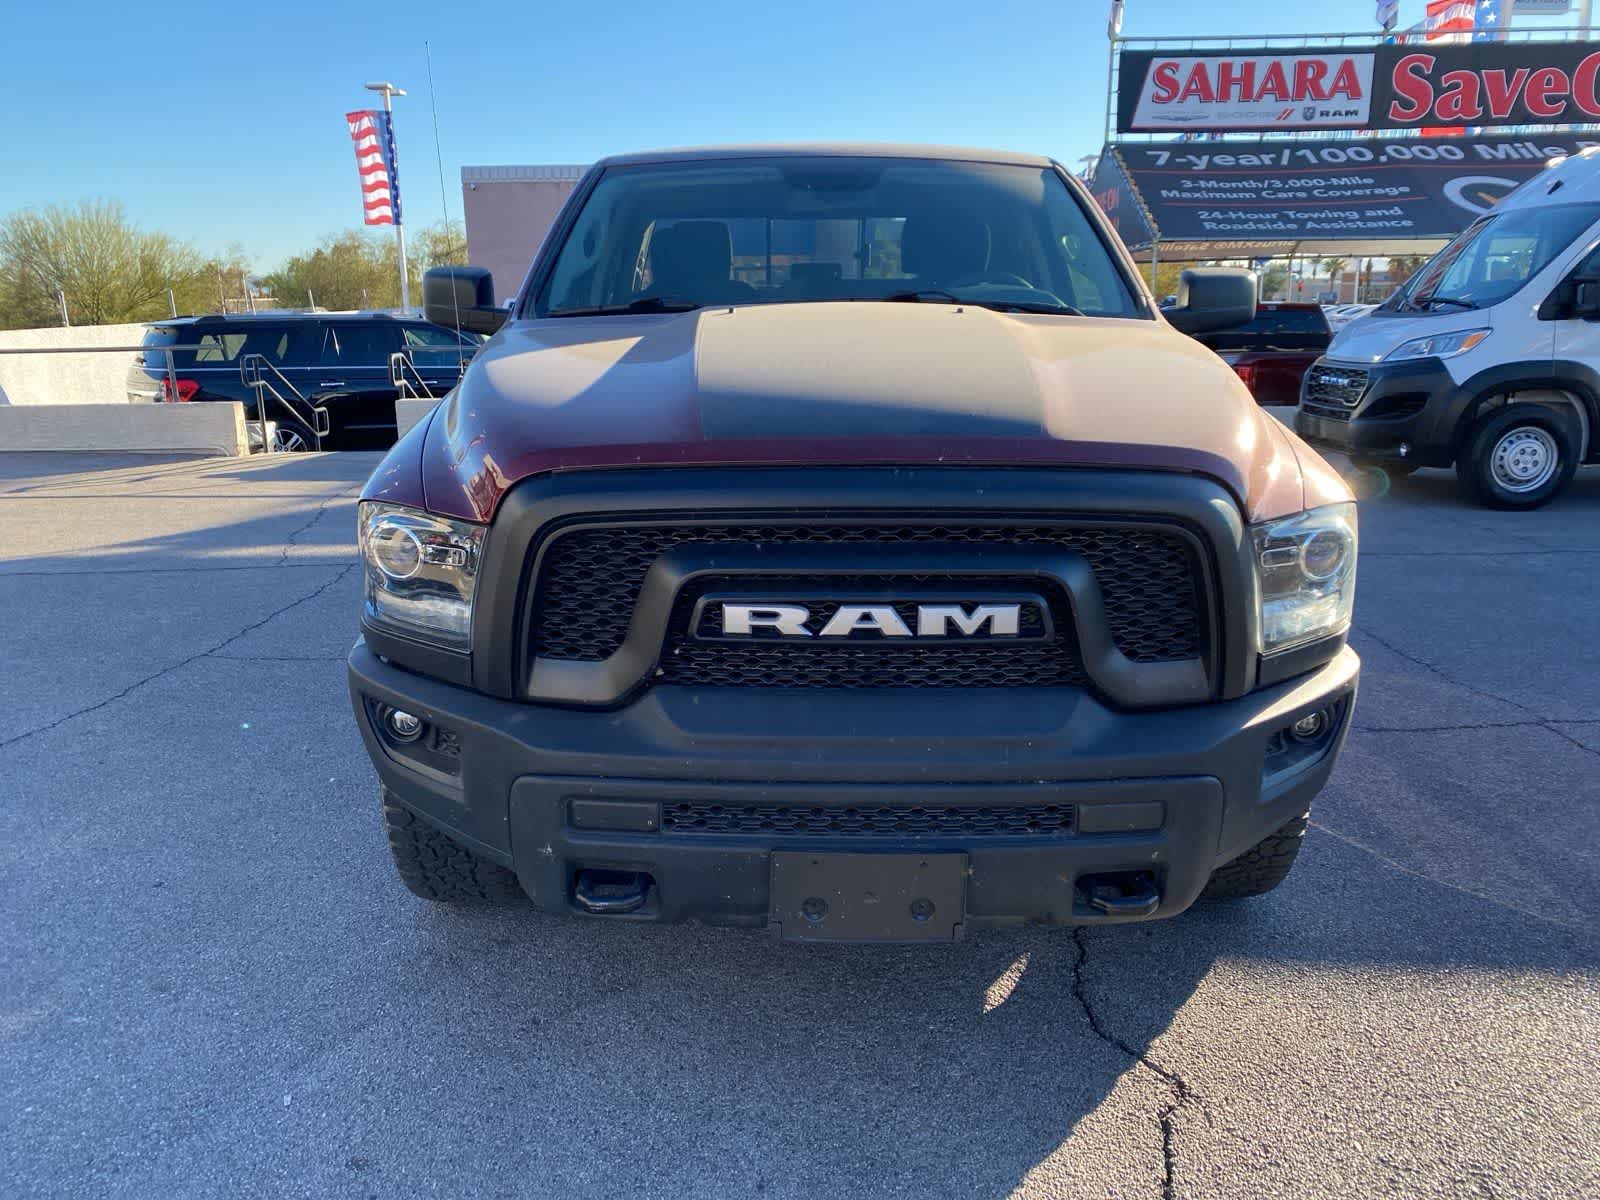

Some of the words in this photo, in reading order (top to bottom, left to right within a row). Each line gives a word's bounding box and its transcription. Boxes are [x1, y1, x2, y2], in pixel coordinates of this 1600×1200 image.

[1152, 59, 1363, 104] SAHARA
[1319, 109, 1360, 118] RAM
[1146, 144, 1465, 170] 7-year/100,000
[1472, 141, 1568, 160] Mile
[1179, 176, 1375, 189] 3-Month/3,000-Mile
[1160, 190, 1257, 200] Maximum
[1261, 190, 1308, 199] Care
[1313, 184, 1411, 198] Coverage
[1197, 210, 1280, 220] 24-Hour
[1287, 209, 1360, 220] Towing
[1365, 206, 1404, 217] and
[1202, 221, 1299, 231] Roadside
[1305, 218, 1415, 230] Assistance
[722, 603, 1021, 636] RAM
